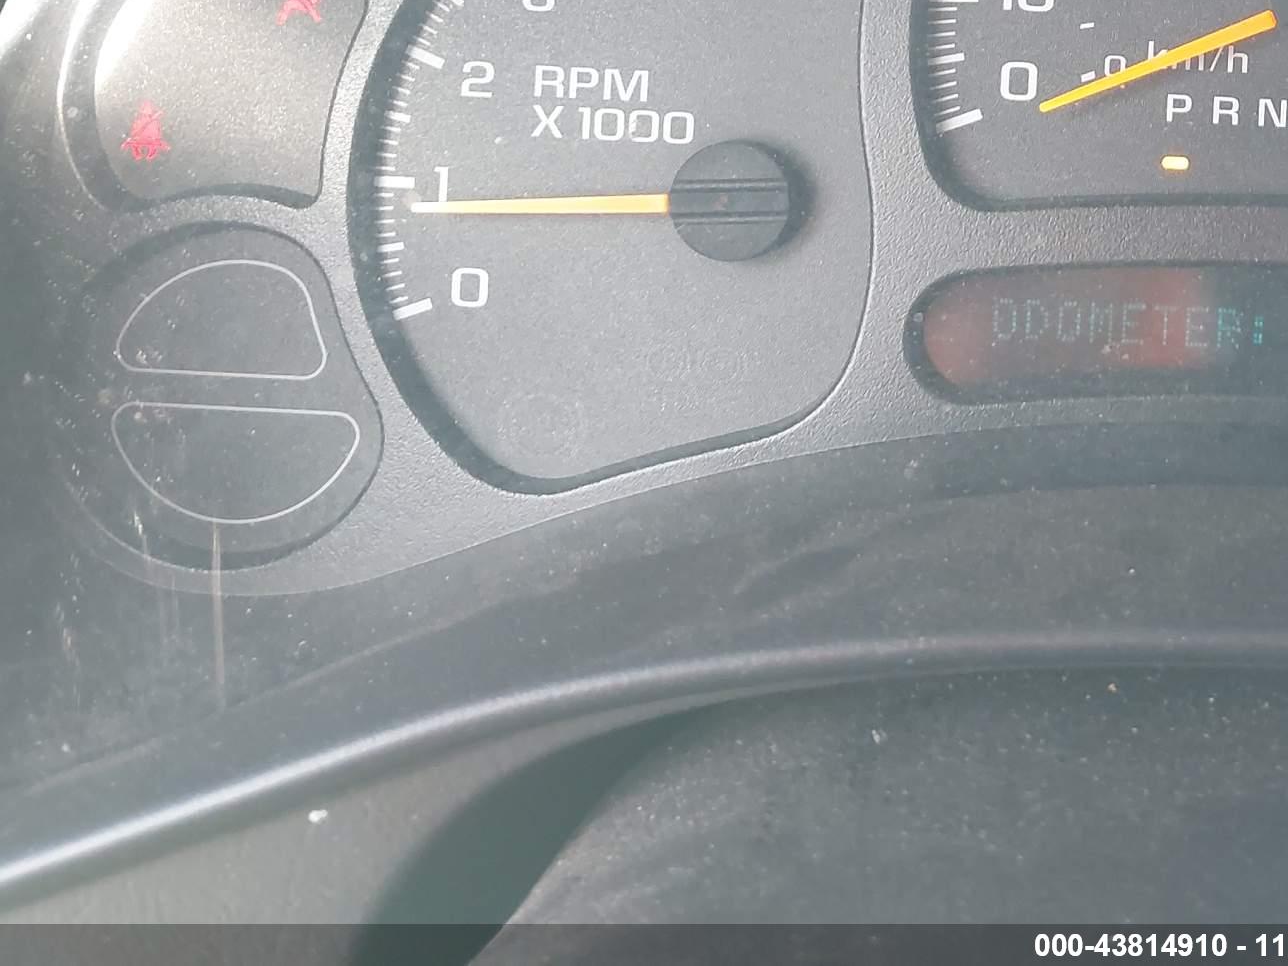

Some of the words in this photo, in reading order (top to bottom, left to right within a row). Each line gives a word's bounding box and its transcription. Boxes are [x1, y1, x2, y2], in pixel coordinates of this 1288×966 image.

[460, 61, 494, 97] 2
[533, 65, 649, 101] RPM
[1000, 62, 1038, 101] 0
[1104, 55, 1127, 79] 0
[531, 105, 563, 138] X
[578, 108, 694, 144] 1000
[1166, 94, 1192, 122] P
[1212, 96, 1240, 125] R
[1258, 100, 1288, 128] N
[434, 167, 449, 202] 1
[451, 268, 489, 307] 0
[992, 297, 1264, 350] ODOMETER:
